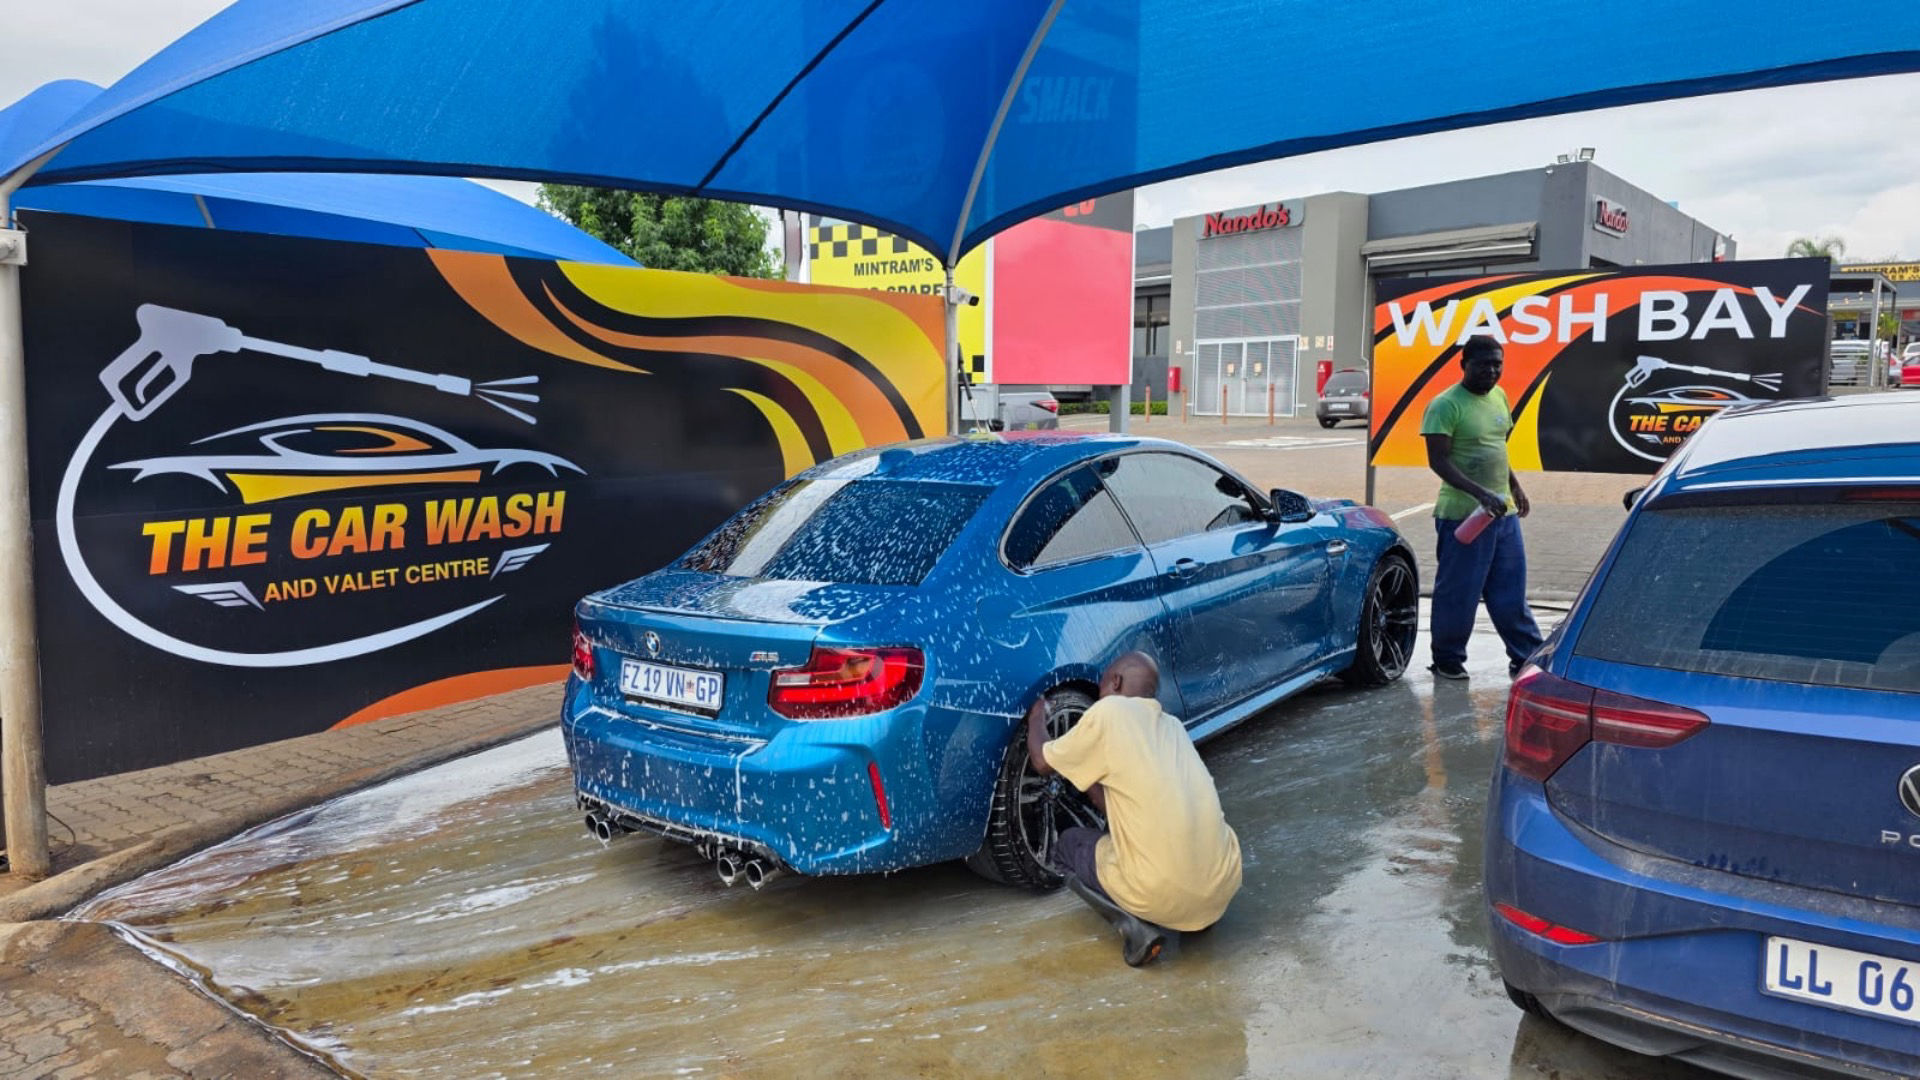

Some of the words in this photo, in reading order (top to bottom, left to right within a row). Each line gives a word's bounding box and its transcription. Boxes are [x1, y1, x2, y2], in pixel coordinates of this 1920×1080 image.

[1203, 203, 1290, 237] Nando's
[854, 257, 934, 276] MINTRAM'S
[1388, 292, 1608, 347] WASH
[1638, 284, 1812, 342] BAY
[1629, 414, 1669, 432] THE
[1673, 414, 1710, 432] CA
[1663, 436, 1681, 444] AND
[142, 513, 272, 575] THE
[290, 503, 407, 559] CAR
[424, 491, 566, 546] WASH
[264, 577, 317, 602] AND
[327, 567, 399, 595] VALET
[405, 557, 490, 584] CENTRE
[1779, 943, 1832, 996] LL
[1859, 960, 1914, 1012] 06
